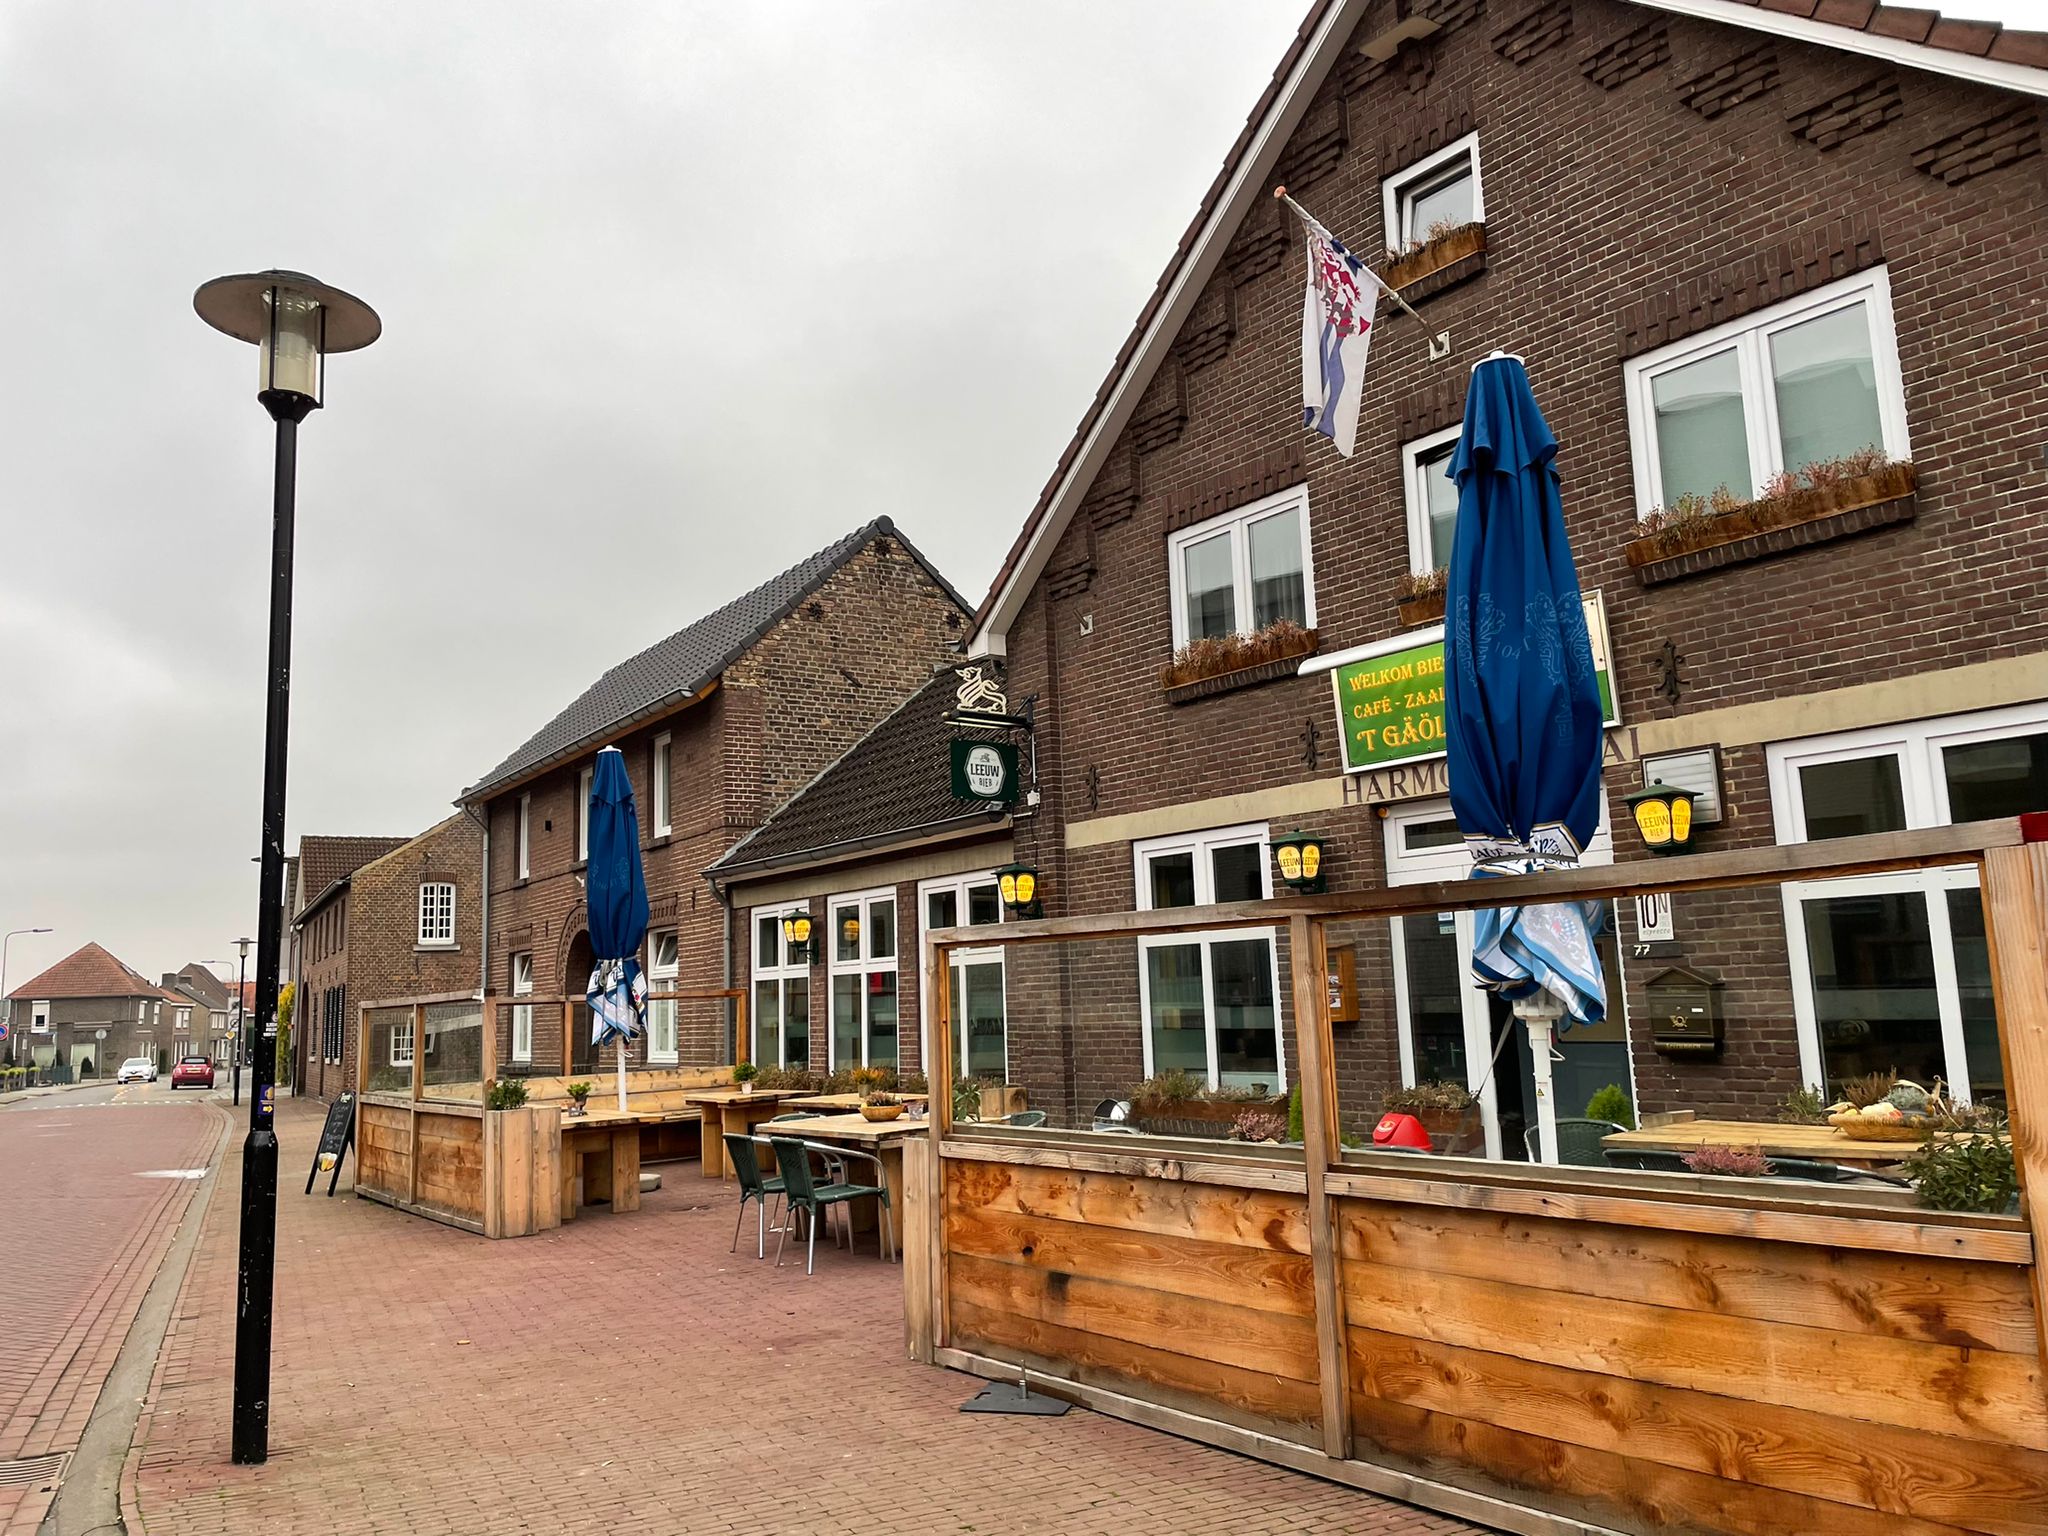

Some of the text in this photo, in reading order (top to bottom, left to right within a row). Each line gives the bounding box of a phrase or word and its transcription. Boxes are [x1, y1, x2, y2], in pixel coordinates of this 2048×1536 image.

[1349, 656, 1446, 692] WELKOM BIE
[1353, 695, 1393, 720] CAFÉ
[970, 763, 1000, 778] LEEUW
[979, 777, 993, 788] BIER
[1638, 814, 1670, 829] LEEUW
[1280, 857, 1300, 868] LEEUW
[1633, 944, 1651, 957] 77
